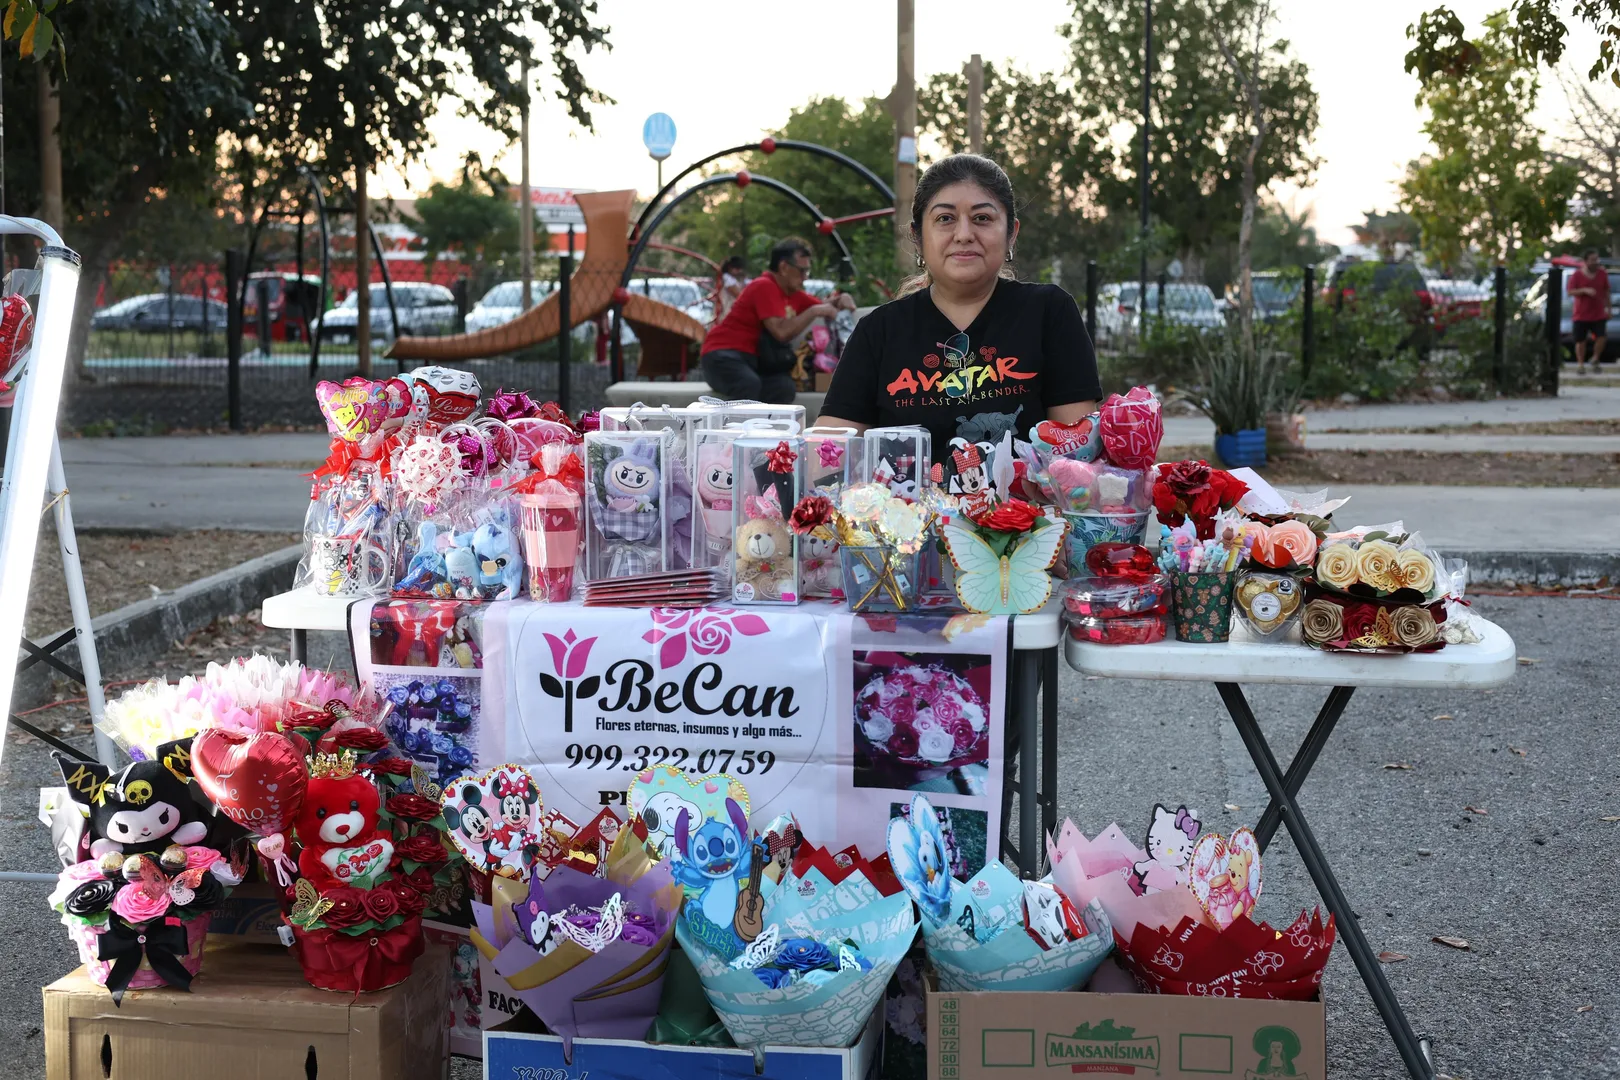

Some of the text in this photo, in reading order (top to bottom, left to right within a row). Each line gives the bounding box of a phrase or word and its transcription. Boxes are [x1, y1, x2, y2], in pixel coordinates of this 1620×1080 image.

[886, 357, 1038, 396] AVATAR
[895, 384, 1027, 408] THE LAST AIRBENDER
[1049, 427, 1071, 442] Te
[1051, 435, 1089, 455] amo
[597, 658, 800, 718] BeCan
[596, 717, 802, 739] Flores eternas, insumos y algo más...
[565, 743, 776, 775] 999.322.0759
[215, 771, 240, 801] Te
[1232, 969, 1248, 978] DAY
[488, 990, 524, 1015] FAC
[942, 1001, 957, 1009] 48
[942, 1014, 957, 1023] 56
[942, 1027, 957, 1036] 64
[942, 1041, 957, 1050] 72
[1049, 1041, 1155, 1060] MANSANÍSIMA
[942, 1054, 957, 1063] 80
[942, 1067, 957, 1076] 88
